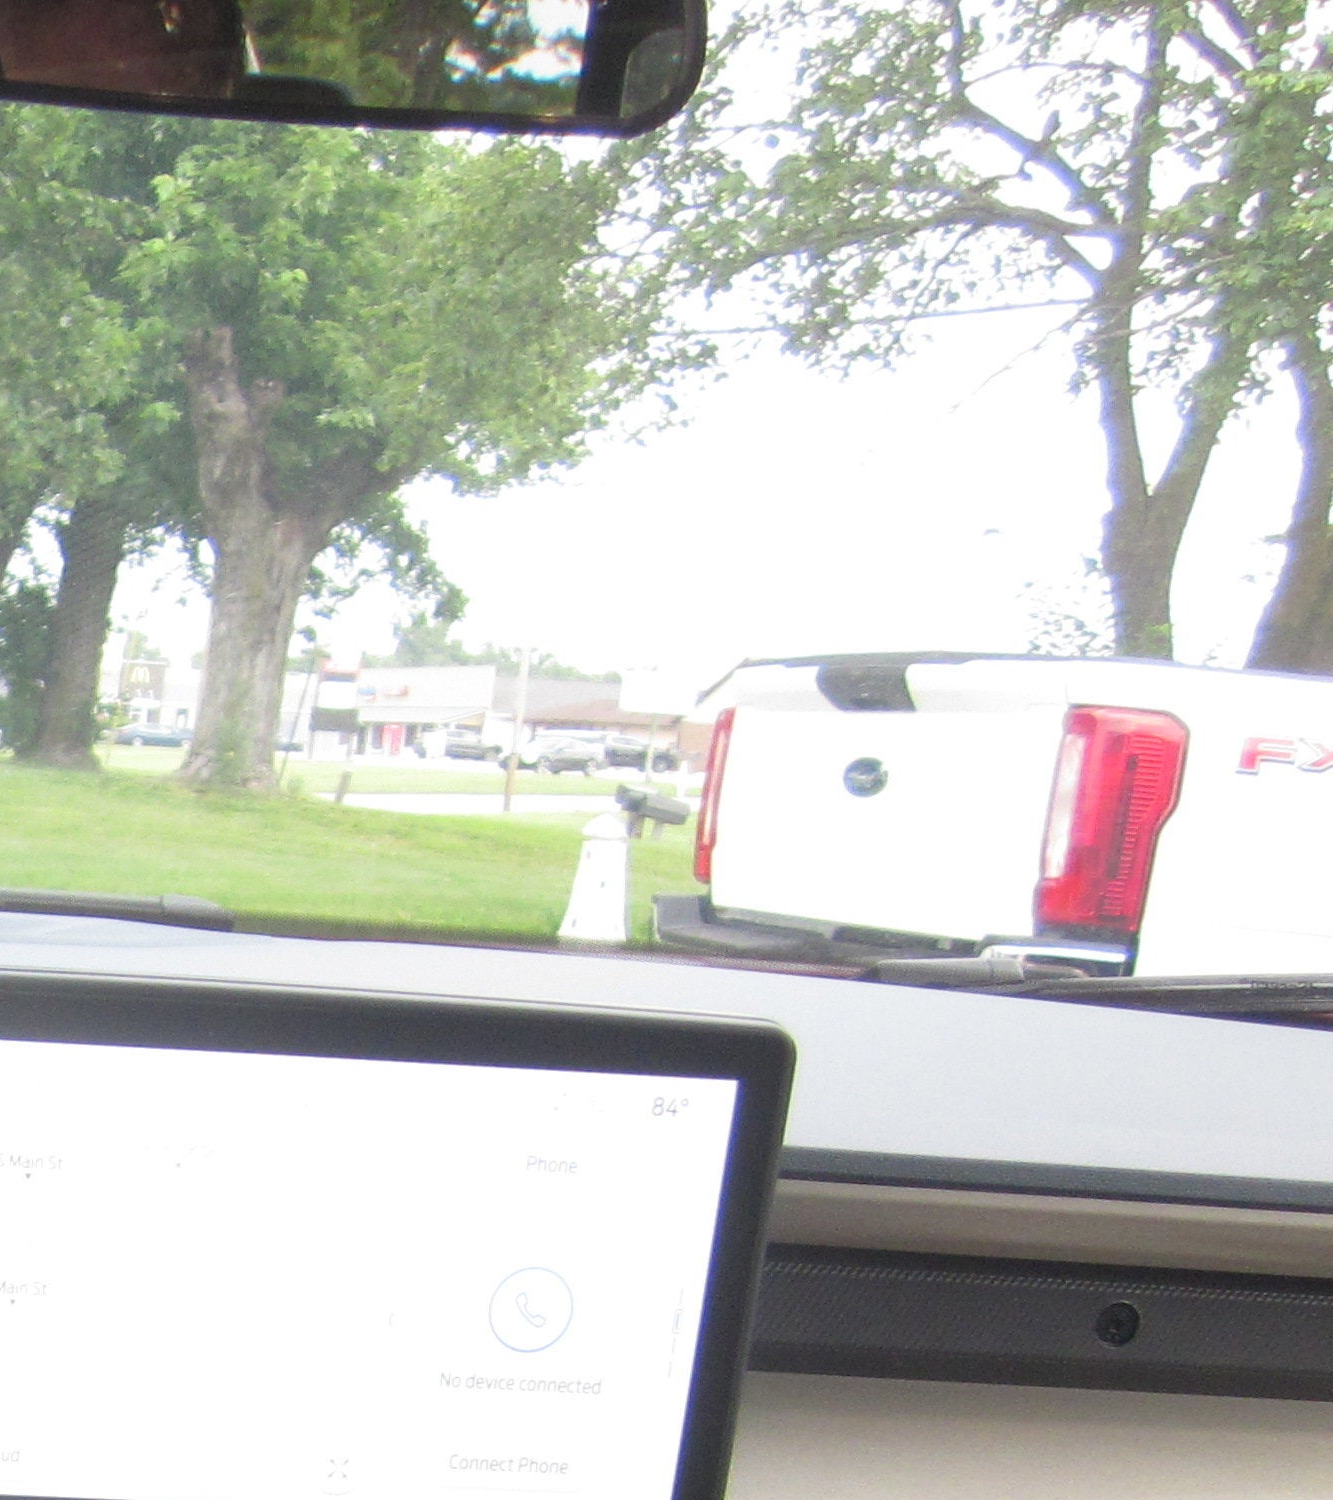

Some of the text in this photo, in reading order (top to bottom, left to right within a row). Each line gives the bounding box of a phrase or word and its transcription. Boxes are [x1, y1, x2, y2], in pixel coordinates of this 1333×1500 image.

[9, 1154, 44, 1170] Main
[48, 1155, 64, 1171] St
[525, 1154, 579, 1175] Phone
[439, 1371, 603, 1398] No device connected
[448, 1452, 571, 1477] Connect Phone
